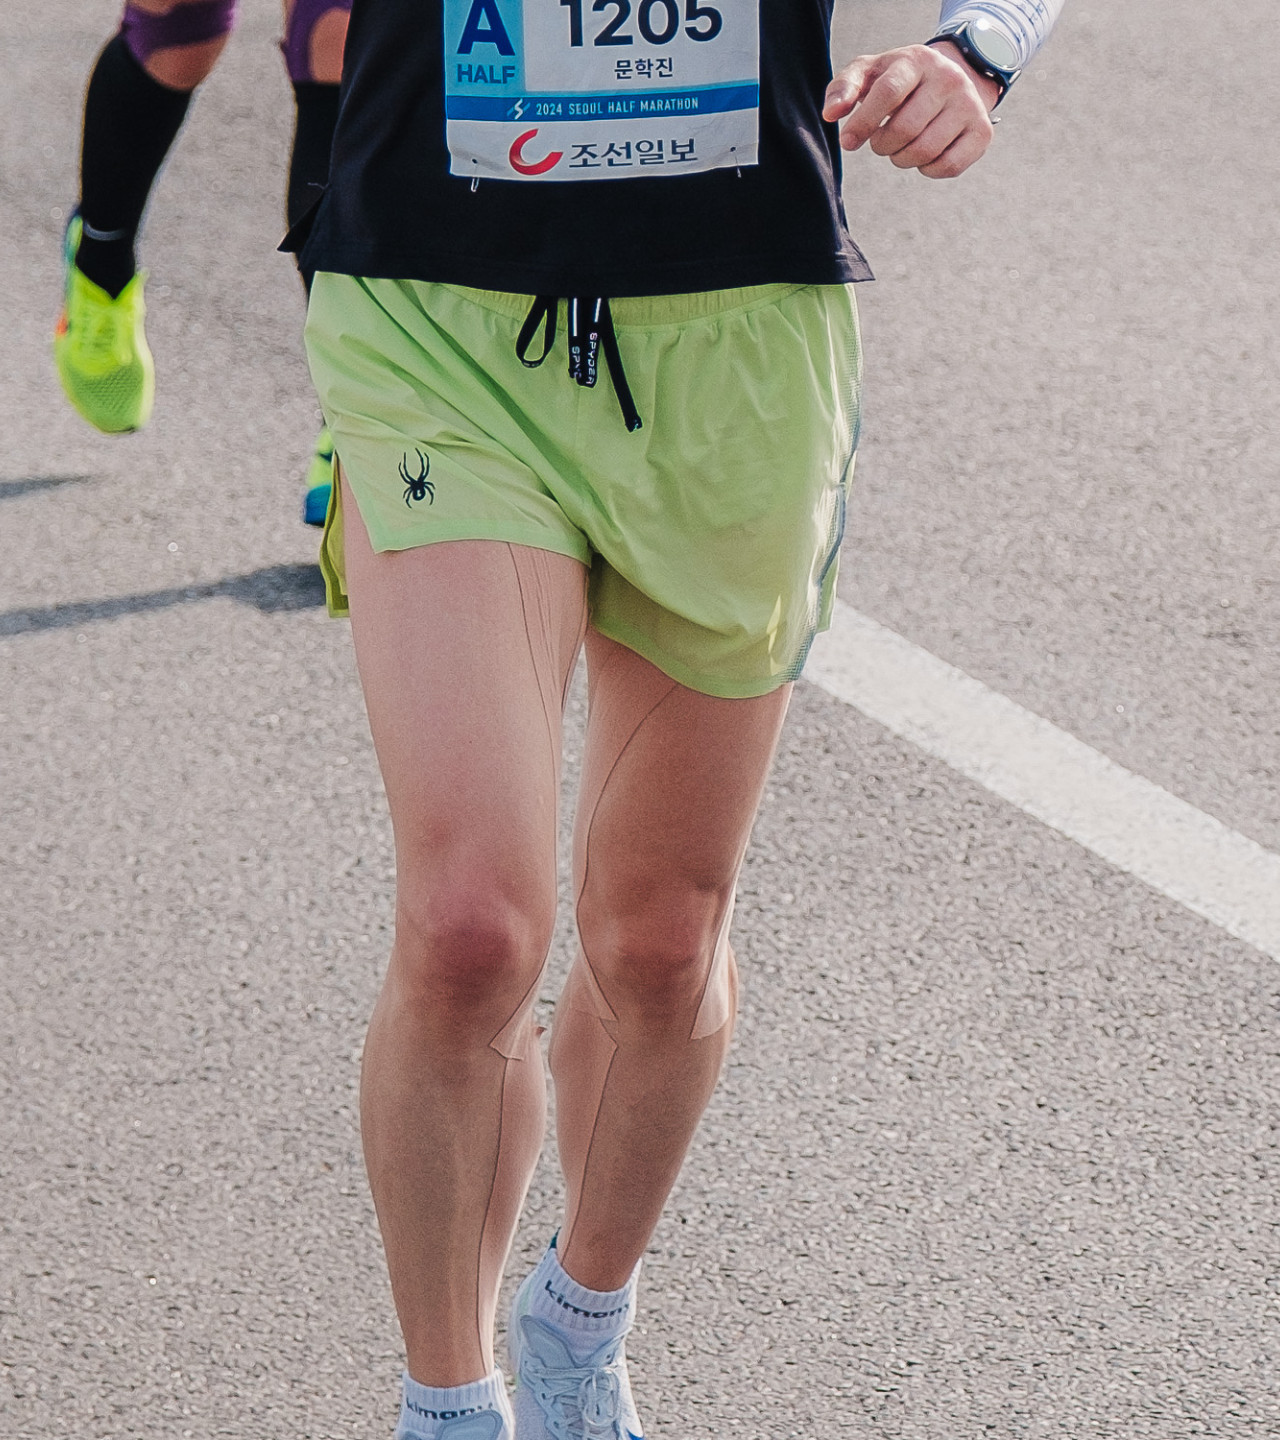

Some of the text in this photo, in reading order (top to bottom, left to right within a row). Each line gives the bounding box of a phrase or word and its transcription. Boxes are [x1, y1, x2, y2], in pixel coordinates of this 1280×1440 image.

[457, 63, 516, 84] HALF
[614, 57, 673, 80] 문학진
[536, 97, 699, 116] 2024 SEOUL HALF MARATHON
[569, 138, 698, 168] 조선일보
